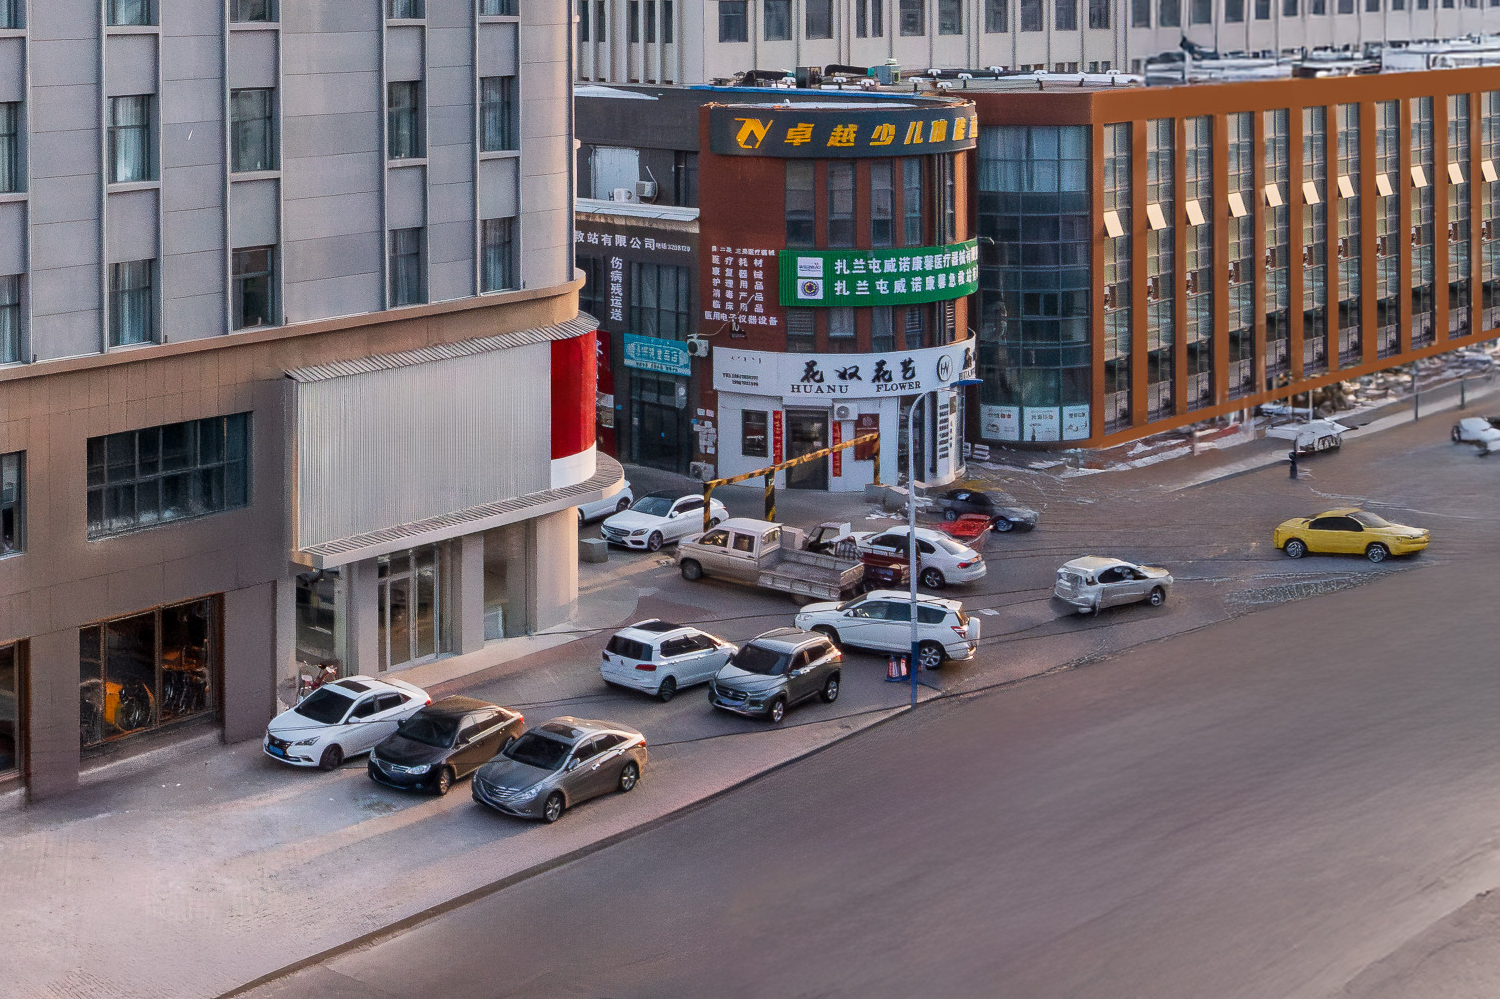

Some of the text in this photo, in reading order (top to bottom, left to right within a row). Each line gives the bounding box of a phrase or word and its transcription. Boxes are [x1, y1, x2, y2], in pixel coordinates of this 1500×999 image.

[610, 256, 623, 322] 伤病残运送
[712, 277, 764, 291] 护理用品
[790, 380, 921, 394] HUANU FLOWER
